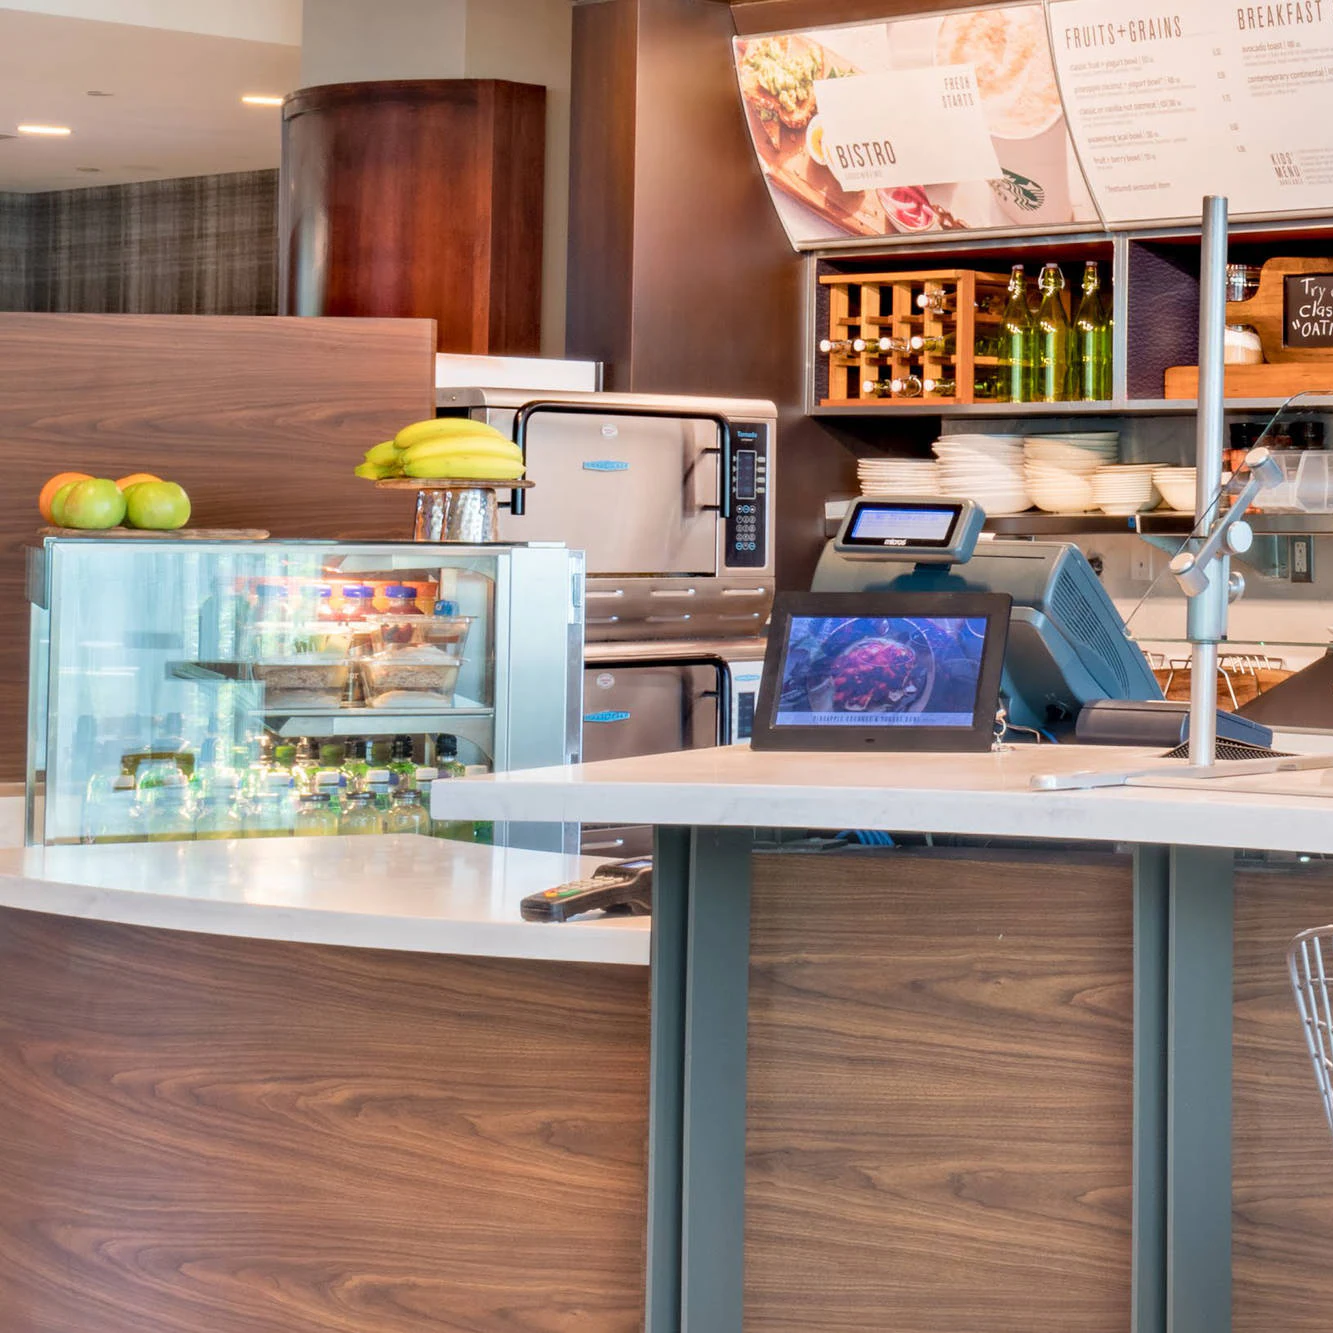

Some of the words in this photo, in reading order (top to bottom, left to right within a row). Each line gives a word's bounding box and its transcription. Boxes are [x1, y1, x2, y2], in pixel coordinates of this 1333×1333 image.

[1237, 0, 1322, 30] BREAKFAST
[836, 141, 896, 168] BISTRO
[1275, 166, 1302, 179] MENU
[1300, 278, 1326, 305] Try
